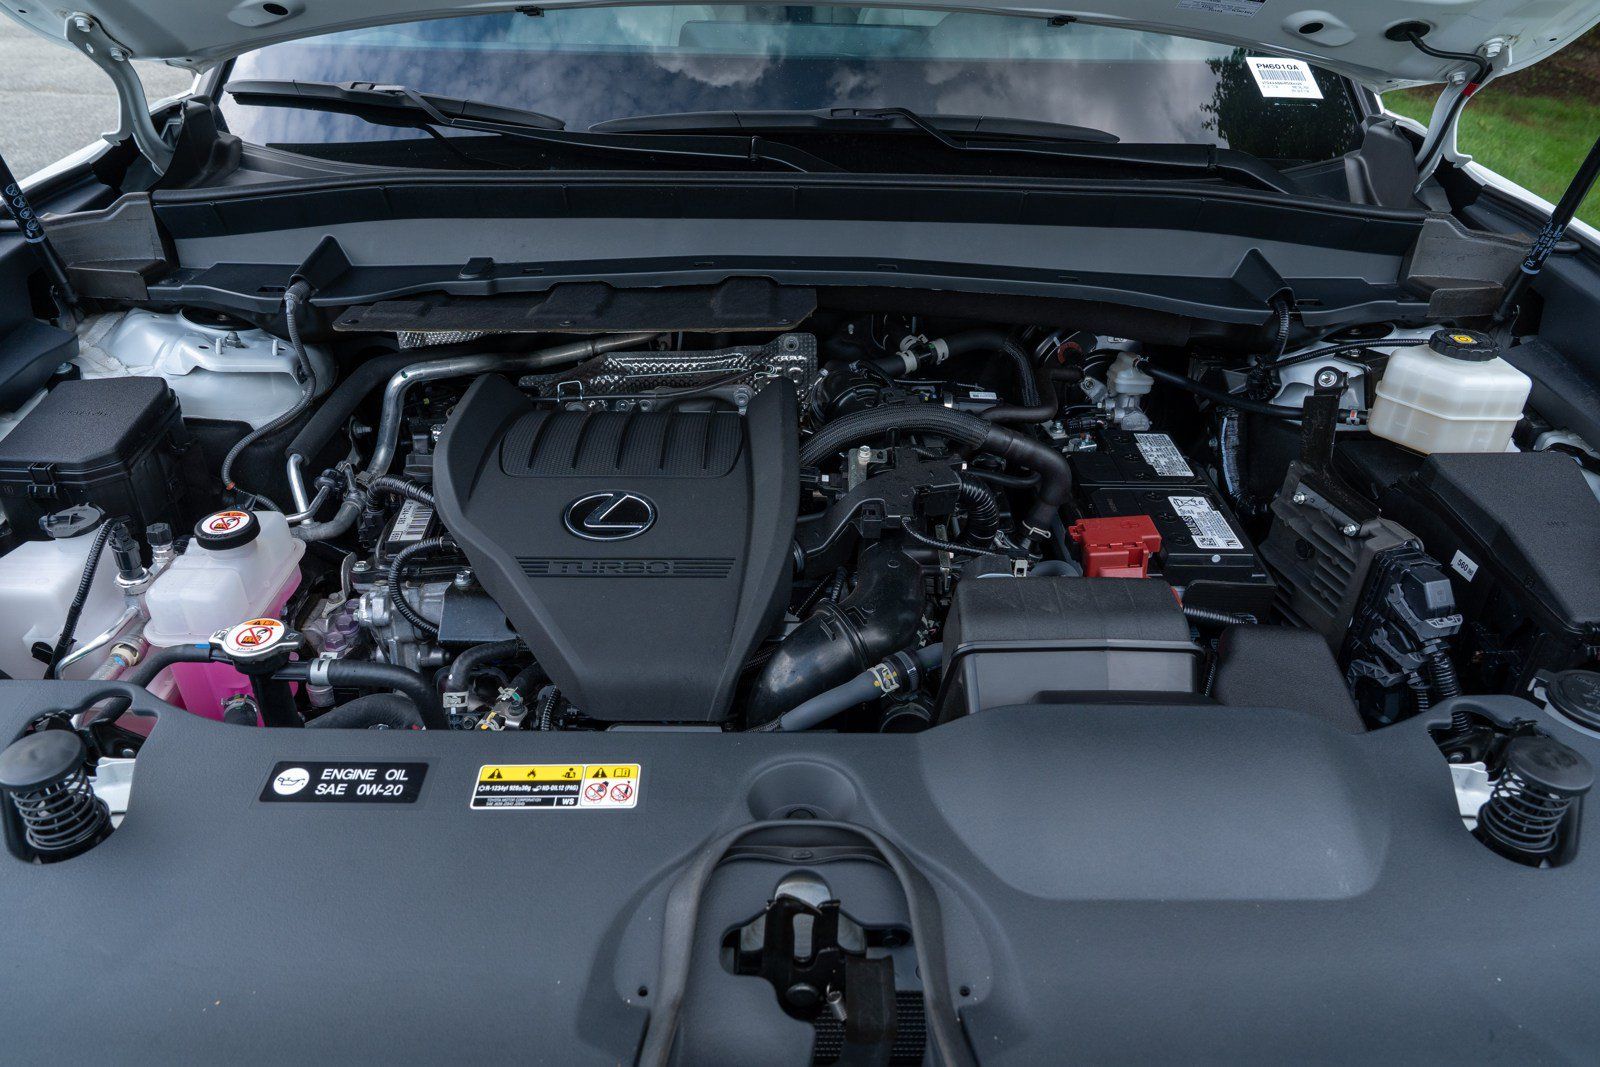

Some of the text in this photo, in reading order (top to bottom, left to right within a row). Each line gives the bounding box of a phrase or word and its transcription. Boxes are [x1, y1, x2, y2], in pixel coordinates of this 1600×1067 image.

[553, 560, 674, 574] TURBO
[320, 768, 409, 781] ENGINE OIL
[314, 783, 404, 796] SAE 0W-20
